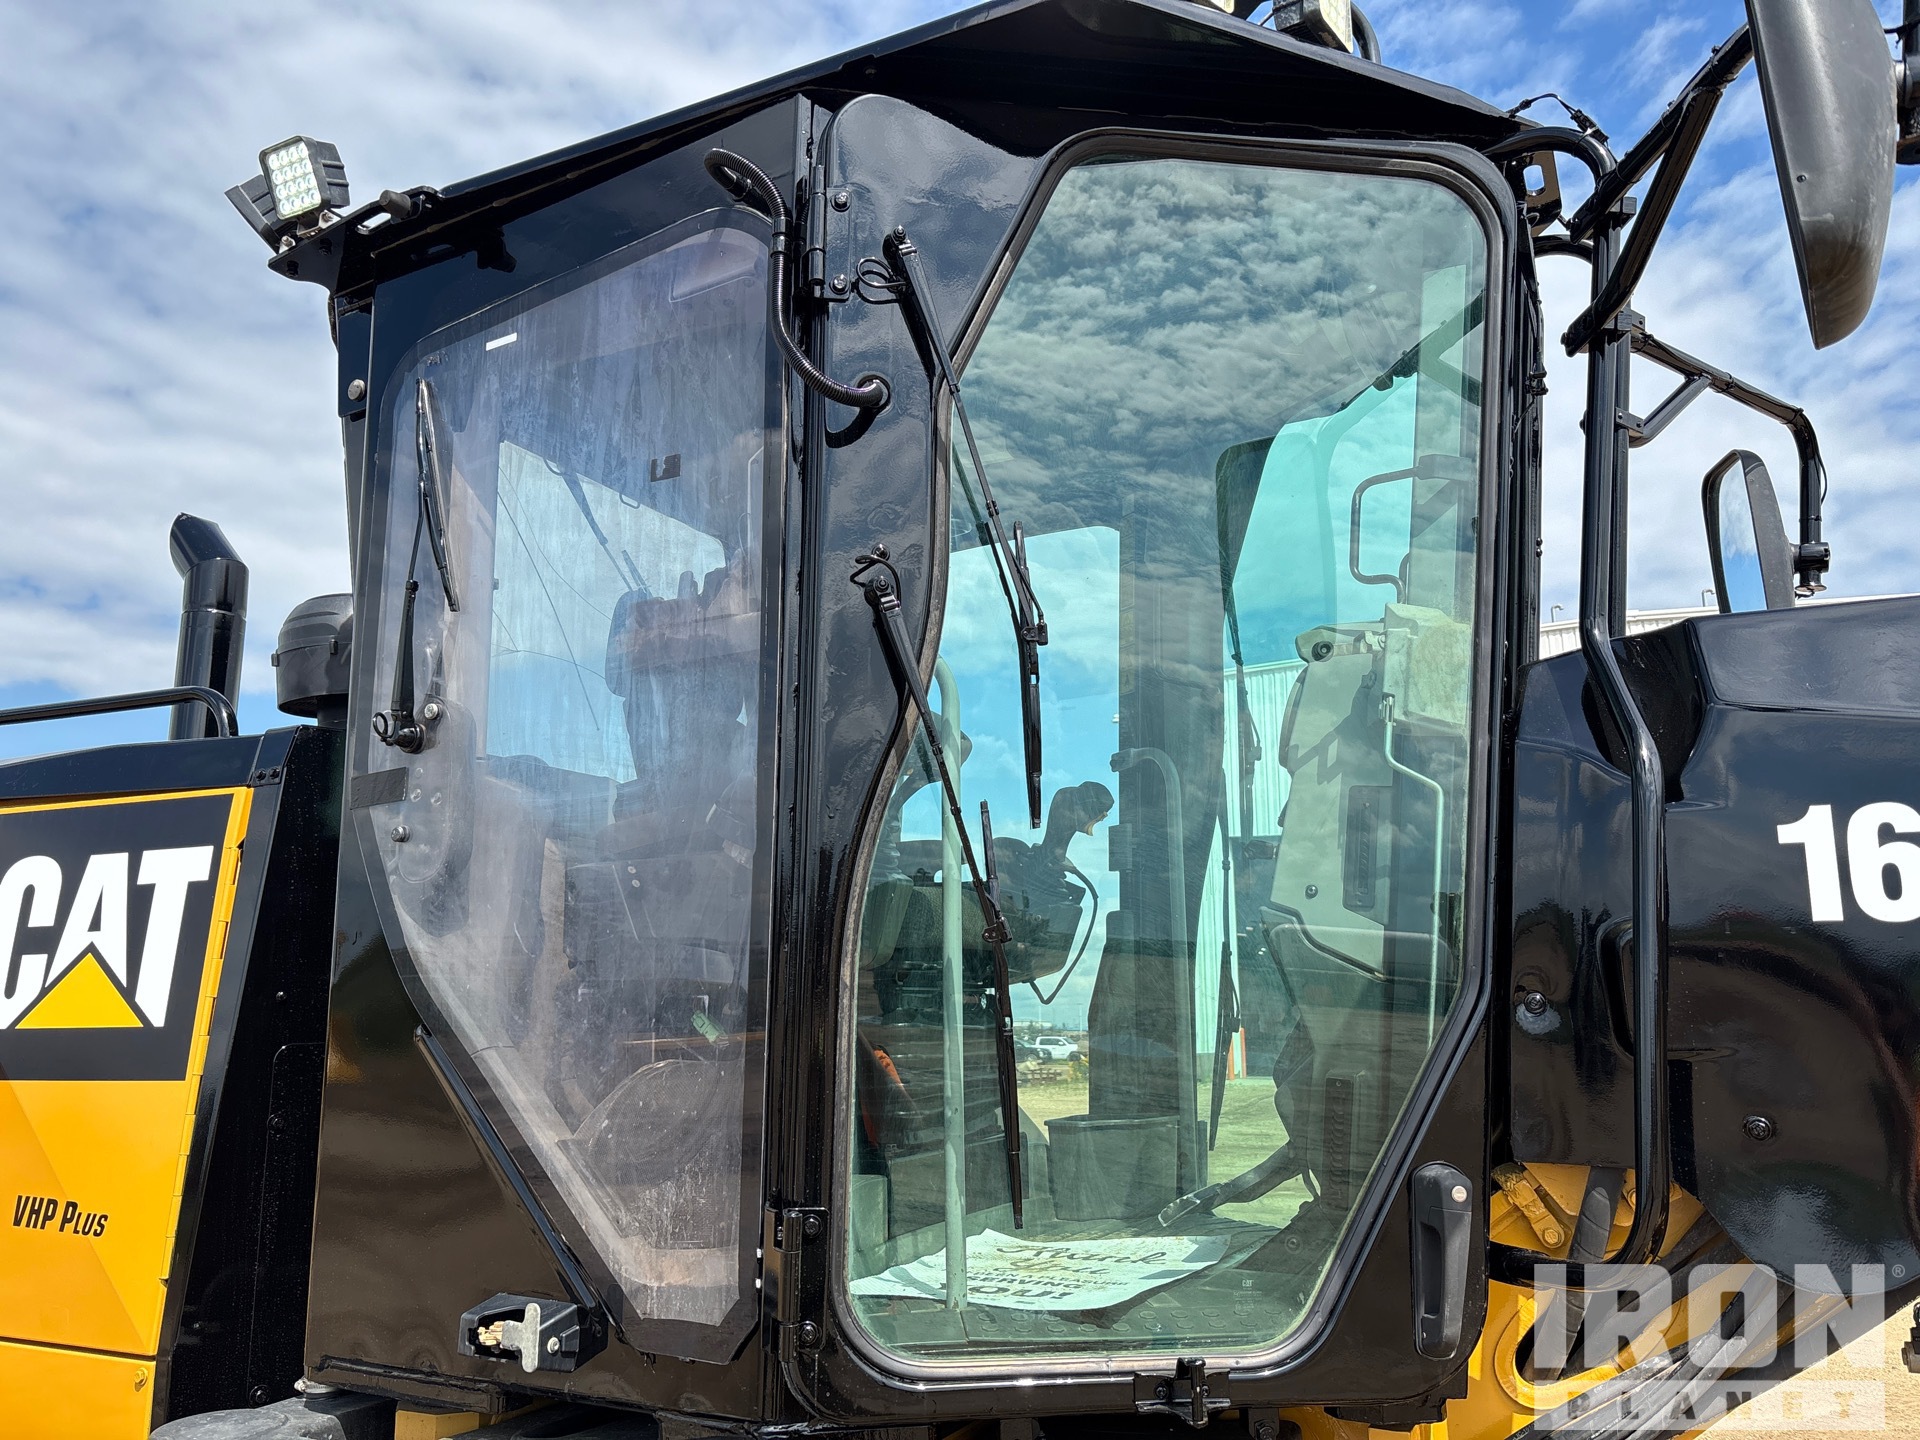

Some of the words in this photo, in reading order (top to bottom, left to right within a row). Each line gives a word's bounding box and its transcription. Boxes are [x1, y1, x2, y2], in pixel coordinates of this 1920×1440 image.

[0, 845, 214, 1029] CAT
[12, 1194, 59, 1230] VHP
[996, 1245, 1167, 1265] Thank
[994, 1258, 1109, 1275] You
[966, 1275, 1082, 1289] SERVING
